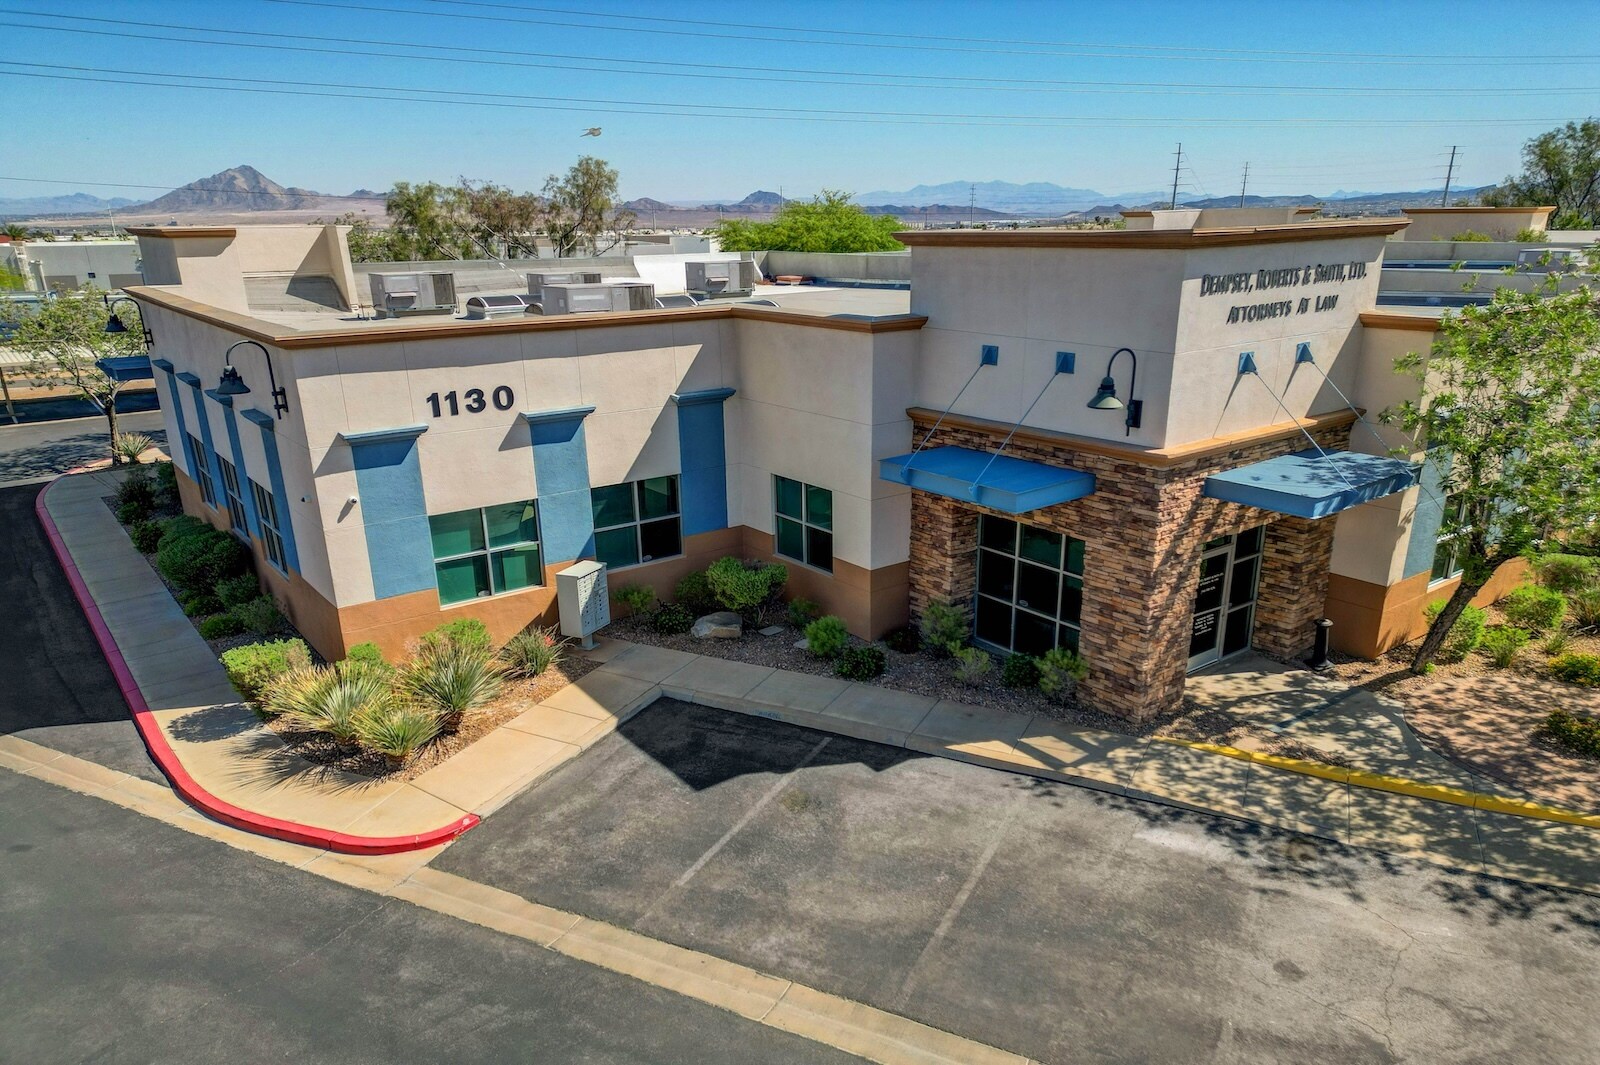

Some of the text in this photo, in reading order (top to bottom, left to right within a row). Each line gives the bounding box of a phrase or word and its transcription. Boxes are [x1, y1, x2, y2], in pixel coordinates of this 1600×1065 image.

[1256, 268, 1300, 290] ROBERTS
[1302, 265, 1311, 285] &
[1226, 294, 1338, 324] ATTORNEYS AT LAW
[426, 385, 514, 417] 1130
